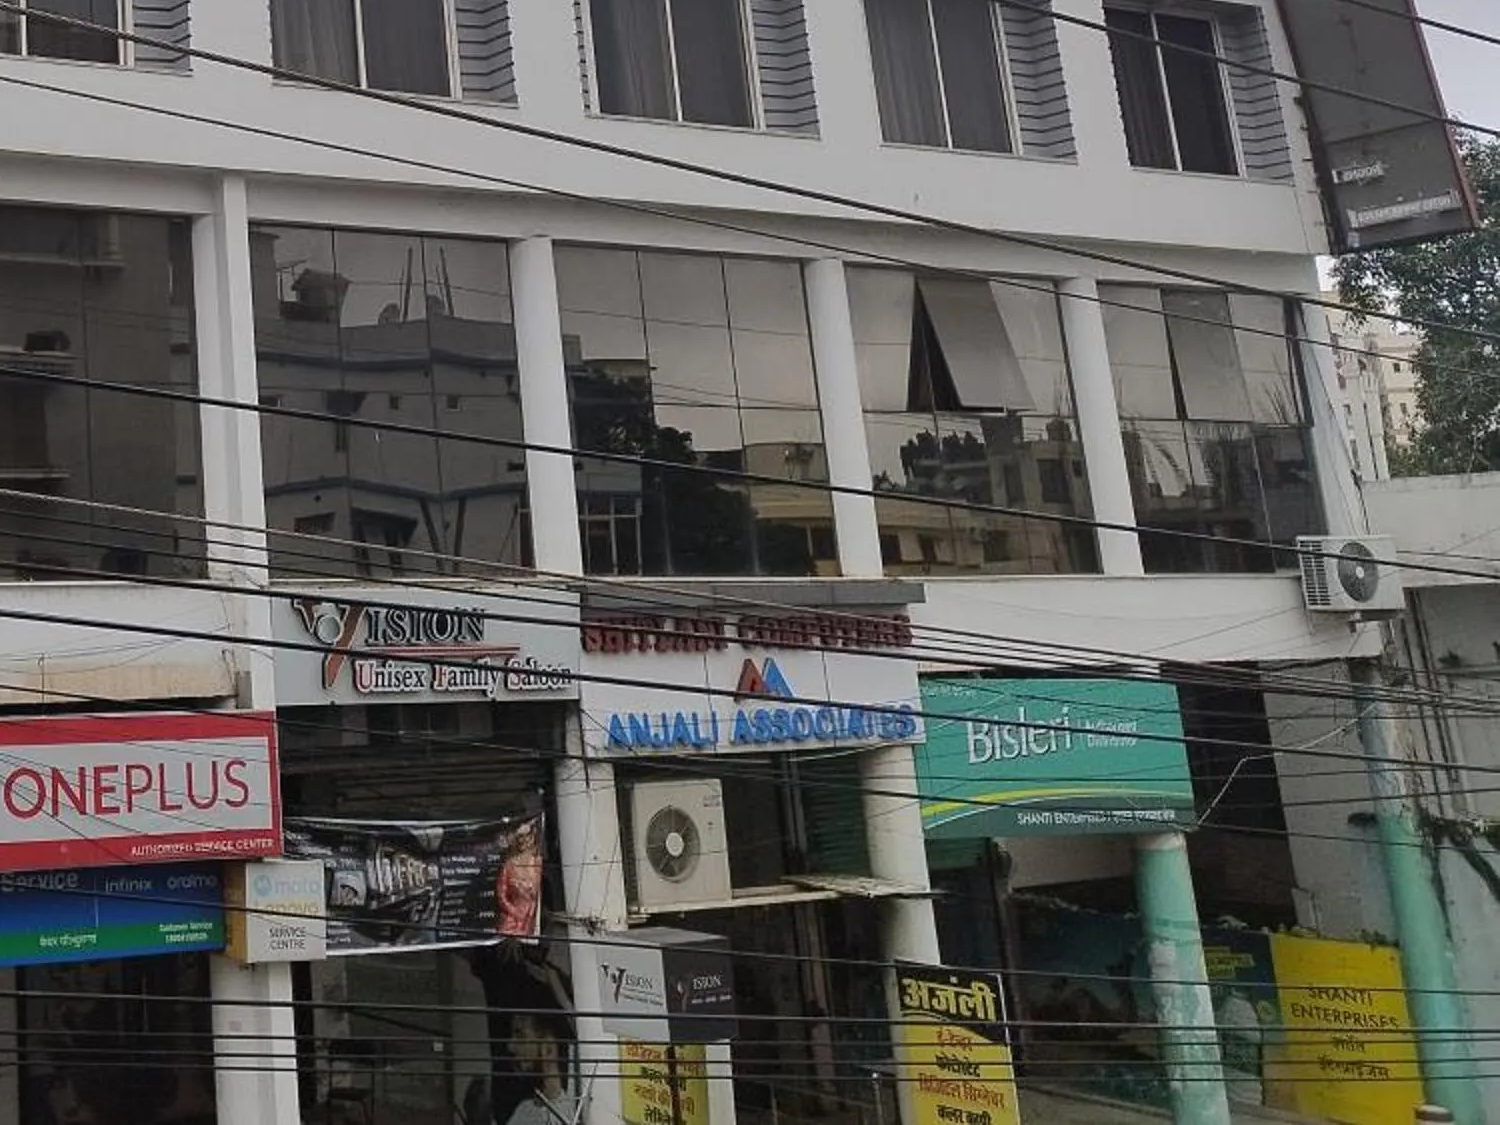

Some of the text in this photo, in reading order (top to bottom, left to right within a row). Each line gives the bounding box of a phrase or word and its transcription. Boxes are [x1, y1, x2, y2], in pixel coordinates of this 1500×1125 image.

[355, 655, 572, 696] Unisex Family Saloon
[606, 704, 918, 750] ANJALI ASSOCIATES
[967, 706, 1072, 764] Bisleri
[3, 758, 250, 820] ONEPLUS
[1017, 811, 1053, 825] SHANTI
[236, 838, 274, 851] CENTER
[1, 872, 79, 892] Service
[269, 926, 306, 938] SERVICE
[269, 939, 306, 950] CENTRE
[1309, 987, 1373, 1007] SHANTI
[1291, 1002, 1399, 1029] ENTERPRISES
